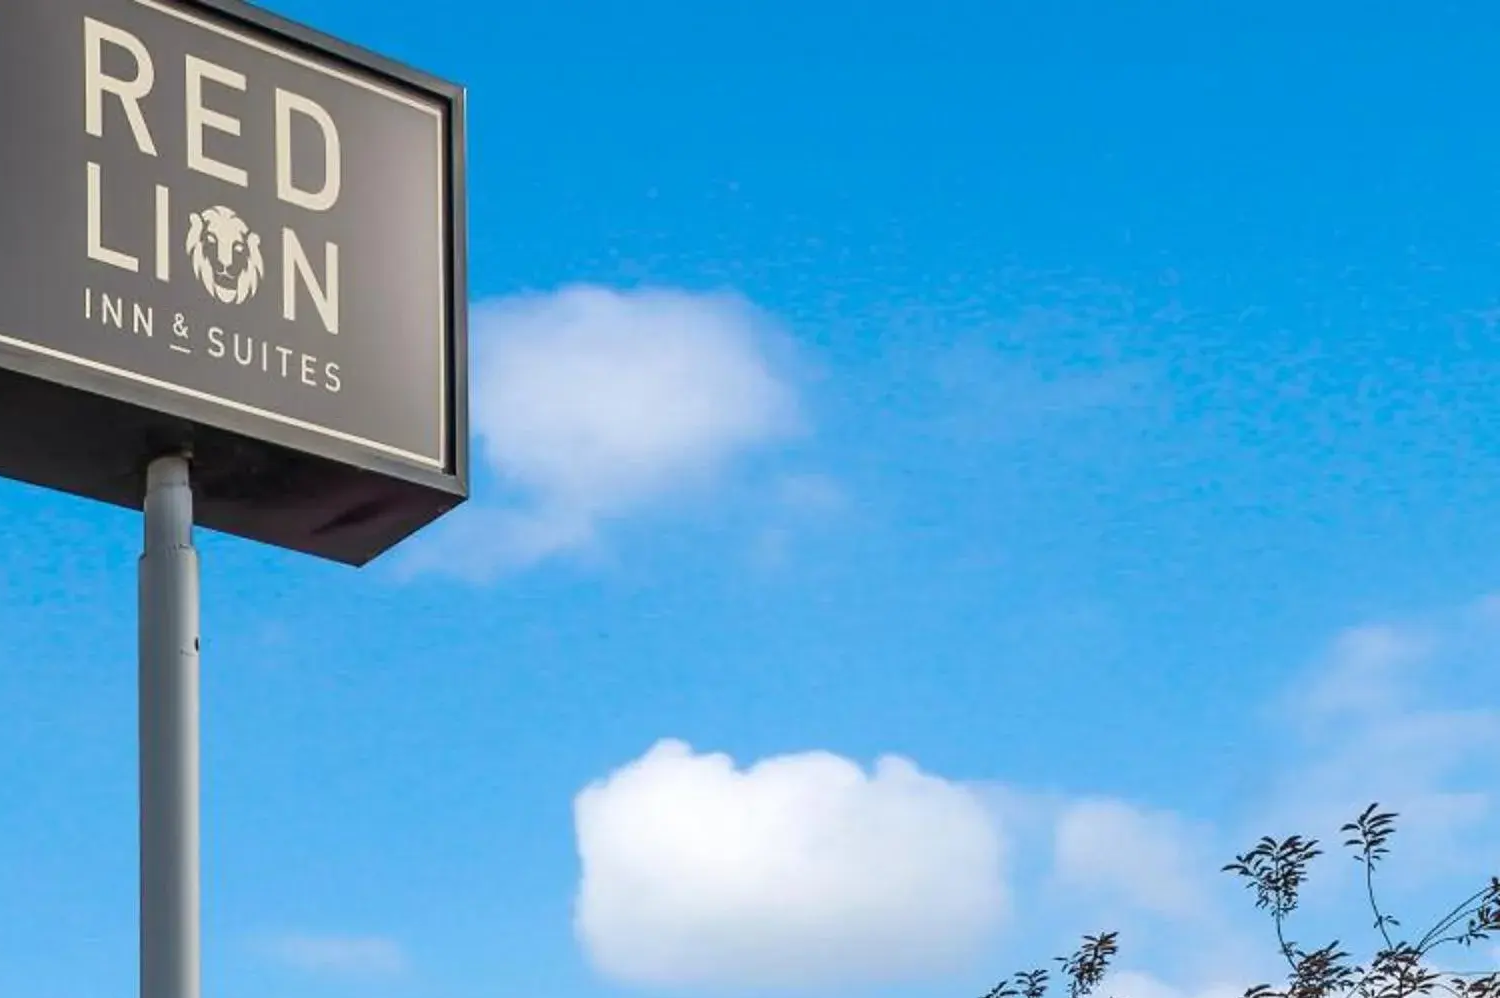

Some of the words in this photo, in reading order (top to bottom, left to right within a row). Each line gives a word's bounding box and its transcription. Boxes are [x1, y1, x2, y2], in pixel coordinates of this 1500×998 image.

[84, 15, 342, 212] RED
[86, 160, 340, 335] LION
[84, 286, 154, 338] INN
[171, 311, 190, 340] &
[207, 325, 342, 393] SUITES
